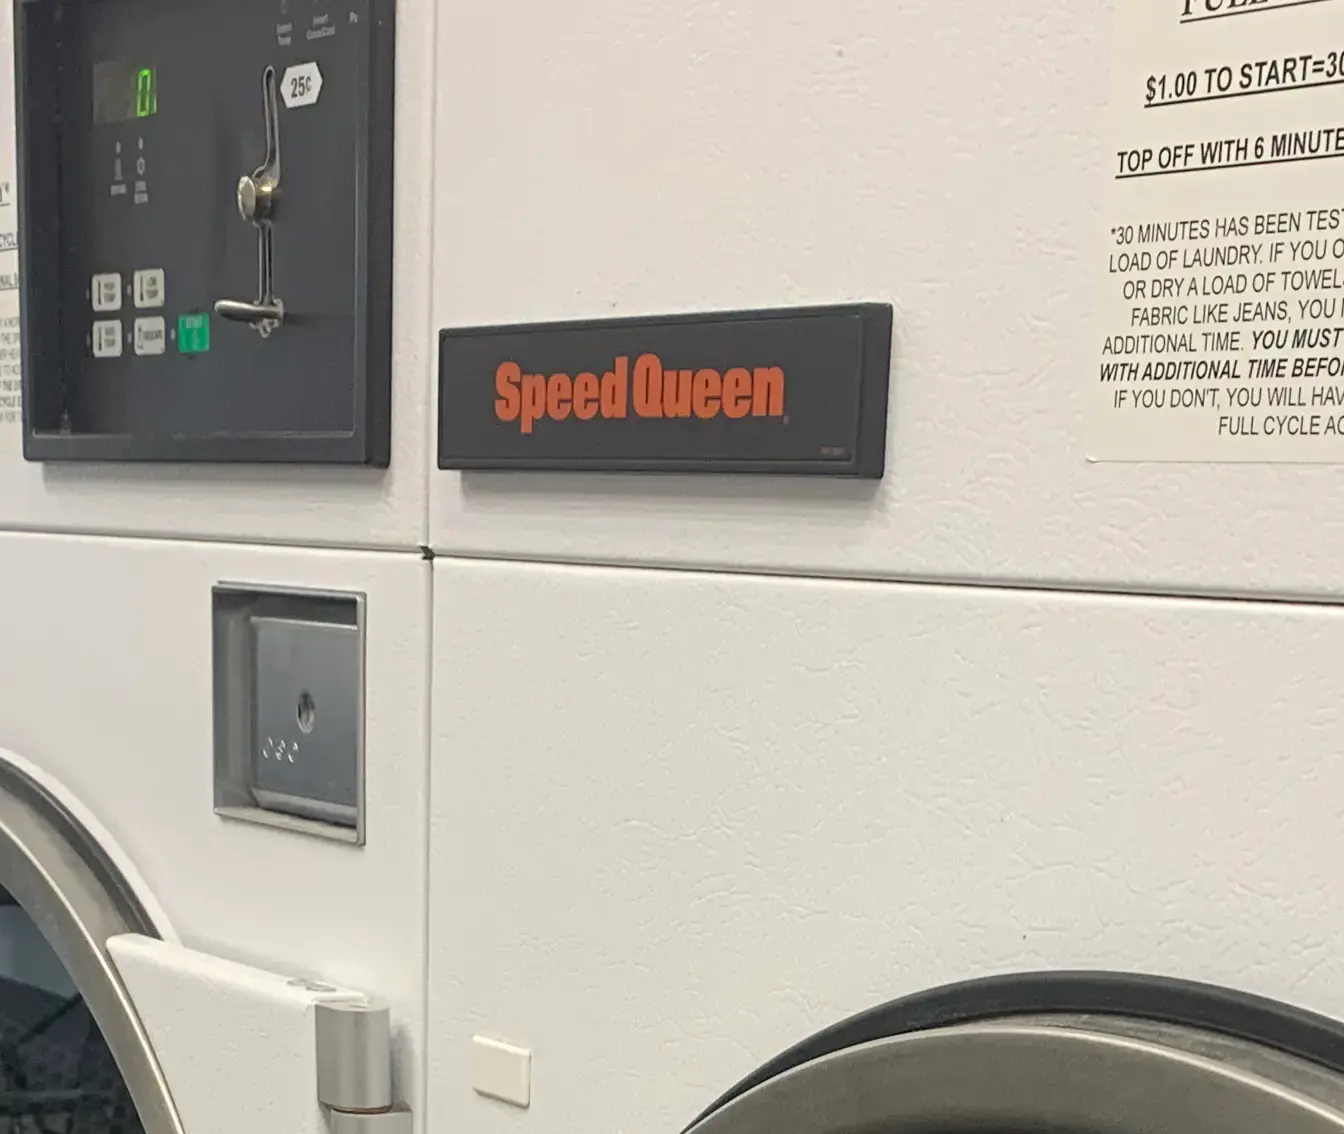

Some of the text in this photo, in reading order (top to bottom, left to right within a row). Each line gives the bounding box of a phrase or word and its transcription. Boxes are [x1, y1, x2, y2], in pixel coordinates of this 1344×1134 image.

[1145, 70, 1197, 104] $1.00
[1204, 66, 1233, 94] TO
[1117, 148, 1153, 173] TOP
[1158, 143, 1195, 169] OFF
[1200, 137, 1249, 165] WITH
[1254, 136, 1265, 160] 6
[1137, 218, 1210, 244] MINUTES
[1215, 215, 1249, 238] HAS
[1254, 211, 1302, 235] BEEN
[1109, 251, 1152, 273] LOAD
[1156, 249, 1179, 270] OF
[1183, 243, 1263, 269] LAUNDRY.
[1269, 241, 1285, 263] IF
[1289, 239, 1328, 262] YOU
[1123, 279, 1146, 300] OR
[1151, 277, 1185, 299] DRY
[1186, 277, 1198, 297] A
[1202, 274, 1248, 296] LOAD
[1252, 272, 1277, 293] OF
[1131, 305, 1188, 327] FABRIC
[1193, 303, 1229, 324] LIKE
[1232, 300, 1291, 324] JEANS,
[1298, 297, 1336, 320] YOU
[1102, 333, 1197, 355] ADDITIONAL
[1201, 331, 1244, 352] TIME.
[1252, 329, 1289, 351] YOU
[1291, 327, 1344, 349] MUST
[1100, 362, 1140, 382] WITH
[1141, 359, 1241, 381] ADDITIONAL
[1248, 358, 1289, 379] TIME
[494, 353, 785, 434] Speed Queen
[1114, 389, 1128, 409] IF
[1132, 389, 1166, 409] YOU
[1170, 388, 1220, 411] DON'T,
[1226, 387, 1263, 408] YOU
[1267, 386, 1307, 407] WILL
[1218, 416, 1259, 436] FULL
[1263, 415, 1321, 436] CYCLE
